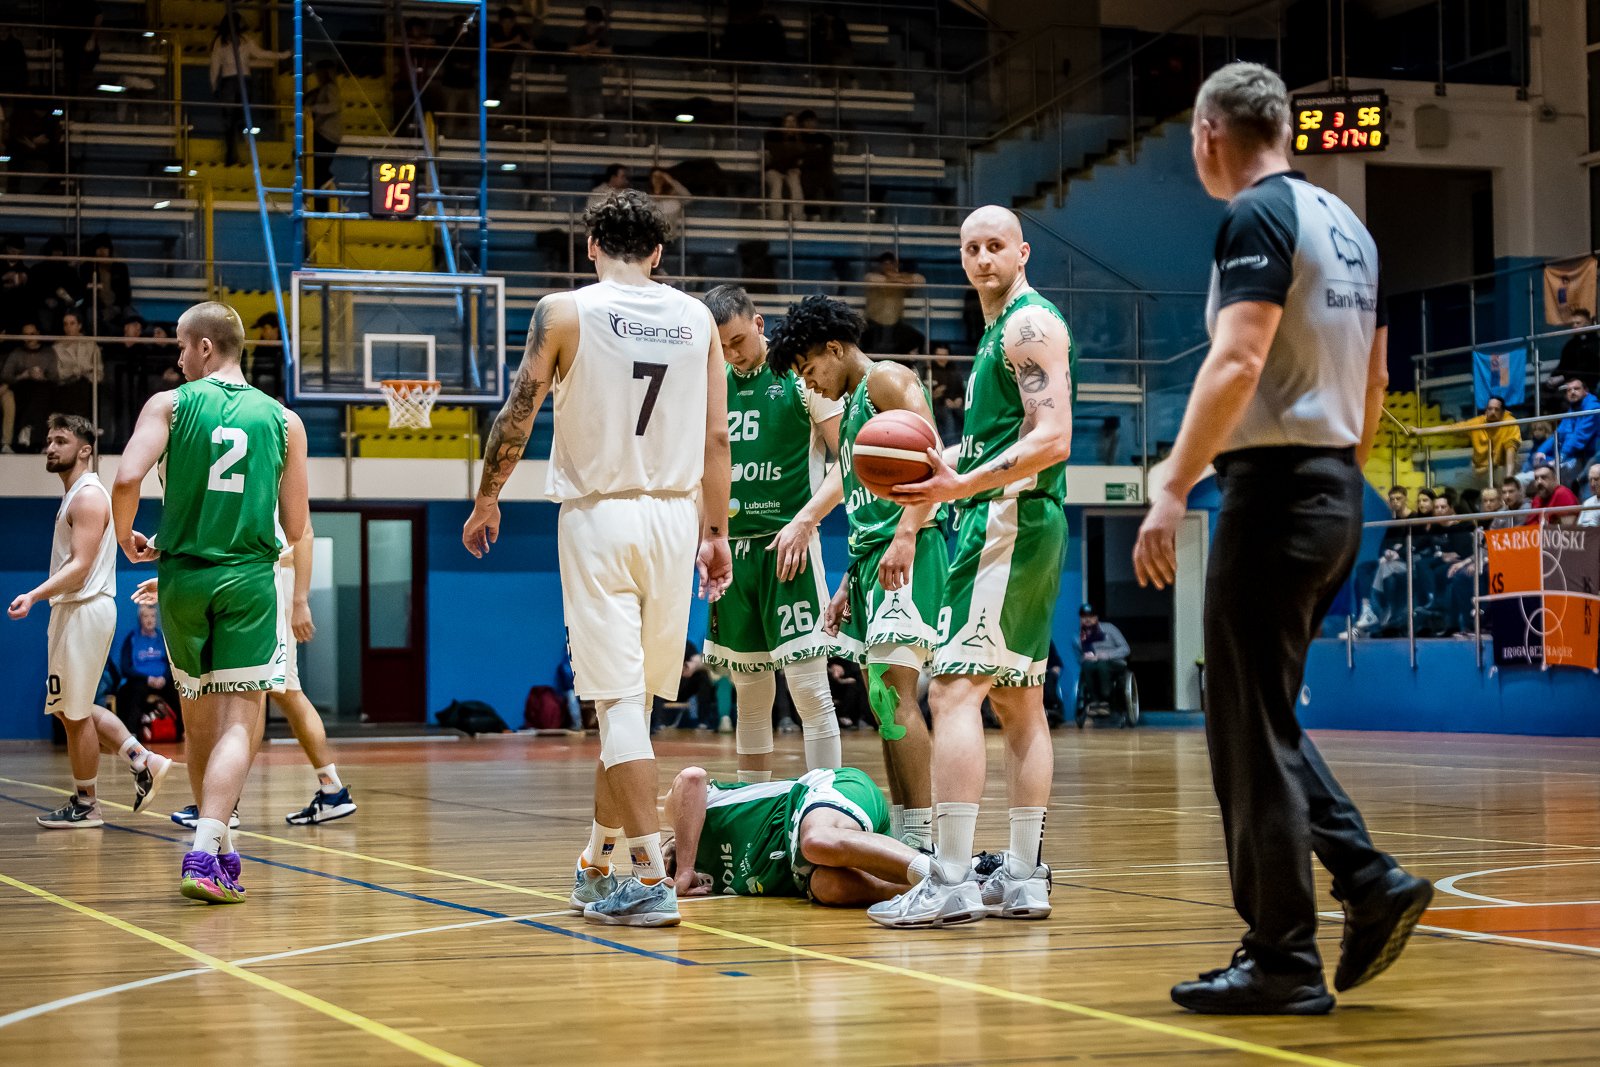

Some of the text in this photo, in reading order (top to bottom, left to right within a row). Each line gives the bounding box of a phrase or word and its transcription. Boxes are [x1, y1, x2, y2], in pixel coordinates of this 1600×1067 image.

[1299, 106, 1381, 130] 52 3 56
[1296, 134, 1309, 151] 0
[385, 182, 410, 212] 15
[622, 321, 693, 340] iSandS
[632, 360, 668, 436] 7
[728, 409, 761, 442] 26
[207, 425, 248, 493] 2
[743, 461, 782, 481] Oils
[744, 500, 781, 510] Lubuskie
[777, 600, 815, 638] 26
[937, 605, 953, 644] 9
[49, 674, 61, 695] 0
